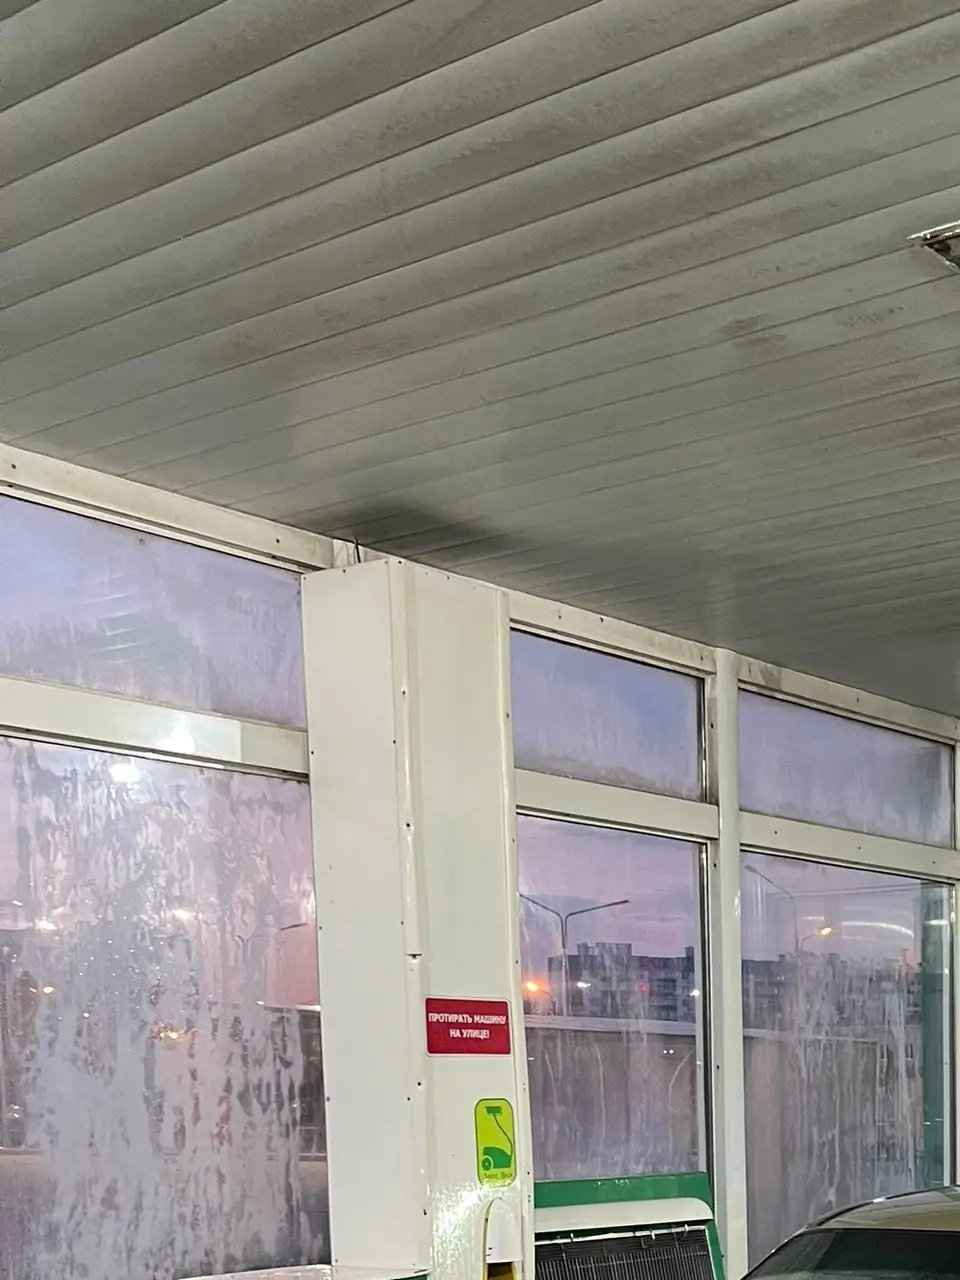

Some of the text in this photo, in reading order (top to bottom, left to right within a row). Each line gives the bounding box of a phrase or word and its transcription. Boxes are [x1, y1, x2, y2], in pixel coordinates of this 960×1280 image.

[428, 1012, 507, 1025] ПРОТИРАТЬ МАШИНУ
[449, 1028, 461, 1038] НА
